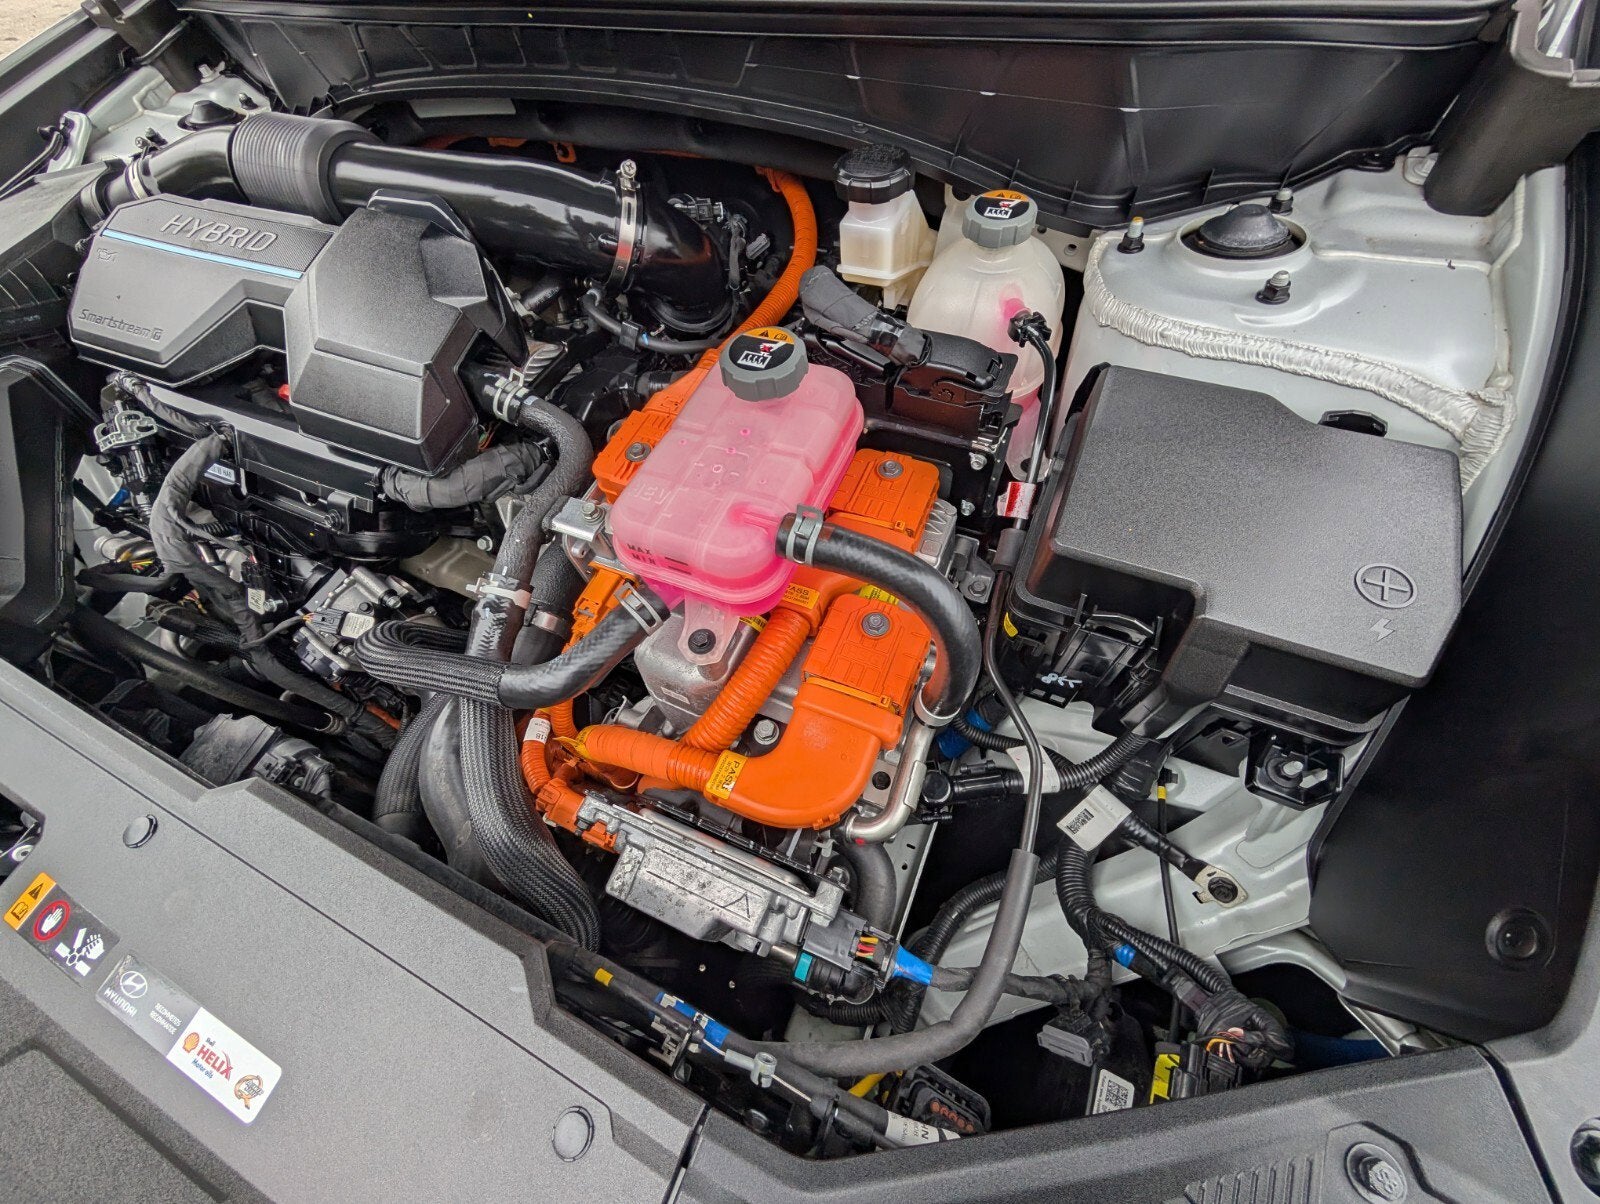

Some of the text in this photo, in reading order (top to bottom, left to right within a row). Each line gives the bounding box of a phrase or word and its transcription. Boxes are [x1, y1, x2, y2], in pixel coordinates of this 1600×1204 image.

[160, 214, 278, 252] HYBRID
[79, 308, 151, 338] Smartstream
[627, 543, 652, 555] MAX
[632, 553, 656, 565] MIN
[103, 987, 138, 1018] HYUNDAI
[197, 1045, 233, 1081] HELIX
